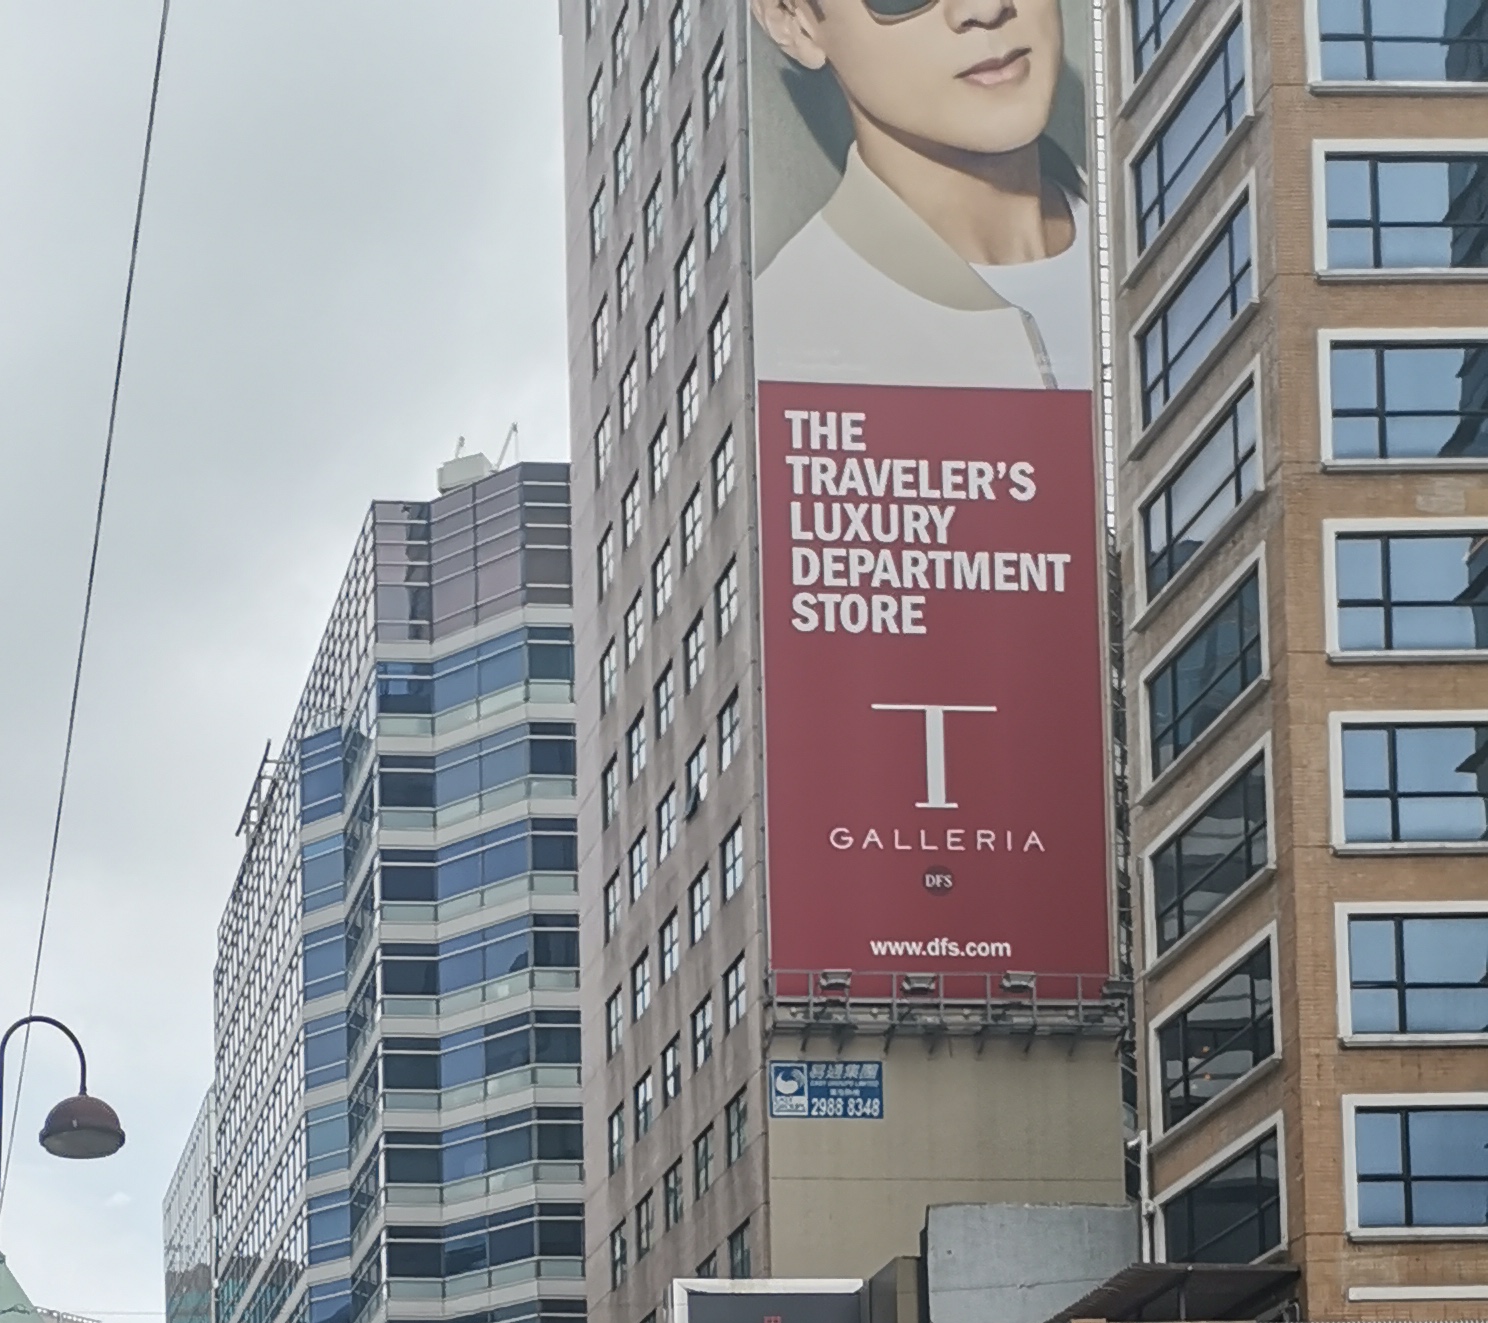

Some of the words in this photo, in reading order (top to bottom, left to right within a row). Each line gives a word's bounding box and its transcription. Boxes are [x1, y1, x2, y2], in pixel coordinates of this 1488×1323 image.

[784, 410, 866, 451] THE
[786, 455, 1037, 501] TRAVELER'S
[790, 501, 955, 545] LUXURY
[791, 548, 1071, 592] DEPARTMENT
[791, 593, 927, 634] STORE
[871, 703, 997, 810] T
[828, 827, 1046, 853] GALLERIA
[924, 872, 953, 889] DFS
[870, 937, 1012, 959] www.dfs.com
